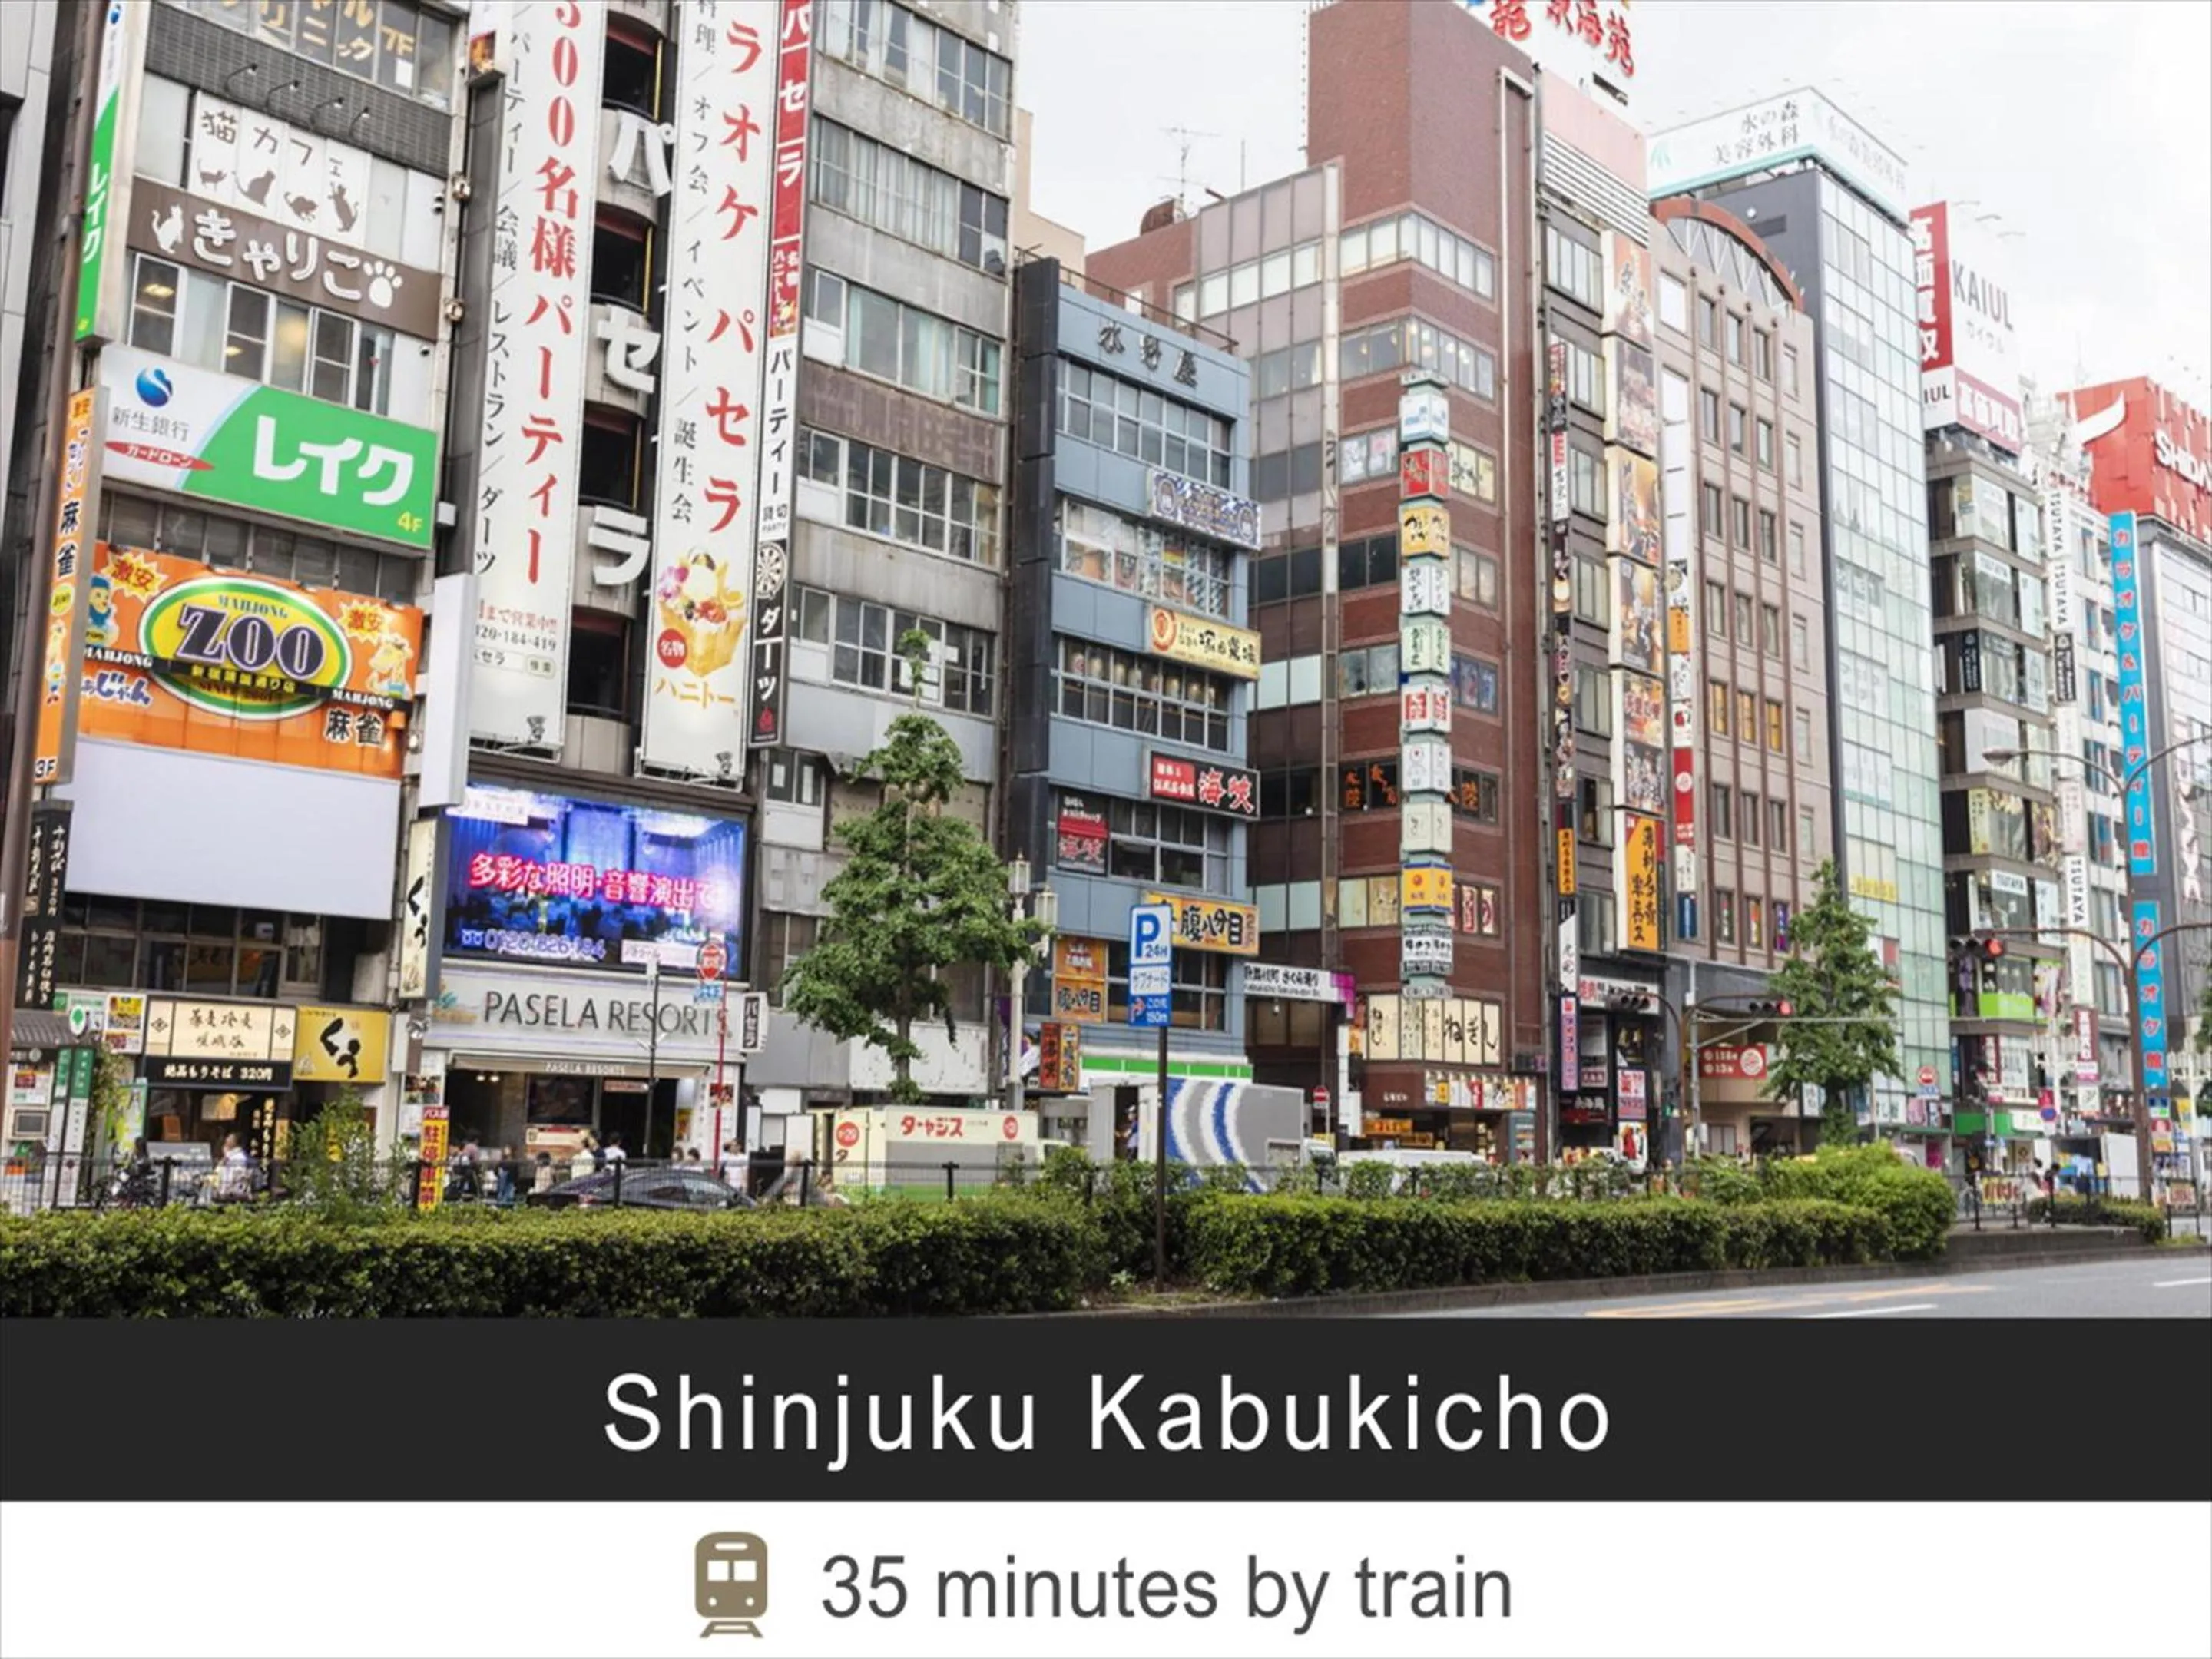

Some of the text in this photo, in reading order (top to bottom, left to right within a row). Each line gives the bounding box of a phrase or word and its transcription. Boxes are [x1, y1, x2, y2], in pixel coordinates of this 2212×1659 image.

[200, 108, 344, 179] 猫カフェ
[82, 162, 109, 264] レイク
[1952, 259, 2014, 332] KAIUL
[587, 108, 677, 586] パセラ
[111, 407, 190, 442] 新生銀行
[704, 308, 756, 534] パセラ
[768, 349, 792, 495] パーティー
[125, 443, 192, 469] カードローン
[253, 414, 414, 506] レイク
[57, 500, 80, 578] 麻雀
[396, 511, 422, 533] 4F
[111, 558, 154, 594] 激安
[2055, 564, 2068, 626] TSUTAYA
[217, 594, 289, 619] MAHJONG
[347, 608, 385, 632] 激安
[83, 644, 153, 670] MAHJONG
[176, 602, 326, 681] ZOO
[757, 605, 781, 702] ダーツ
[332, 689, 394, 710] MAHJONG
[654, 677, 737, 709] ハニトー
[325, 709, 384, 746] 麻雀
[35, 757, 57, 780] 3F
[2070, 859, 2085, 924] TSUTAYA
[1135, 912, 1161, 959] P
[485, 990, 599, 1031] PASELA
